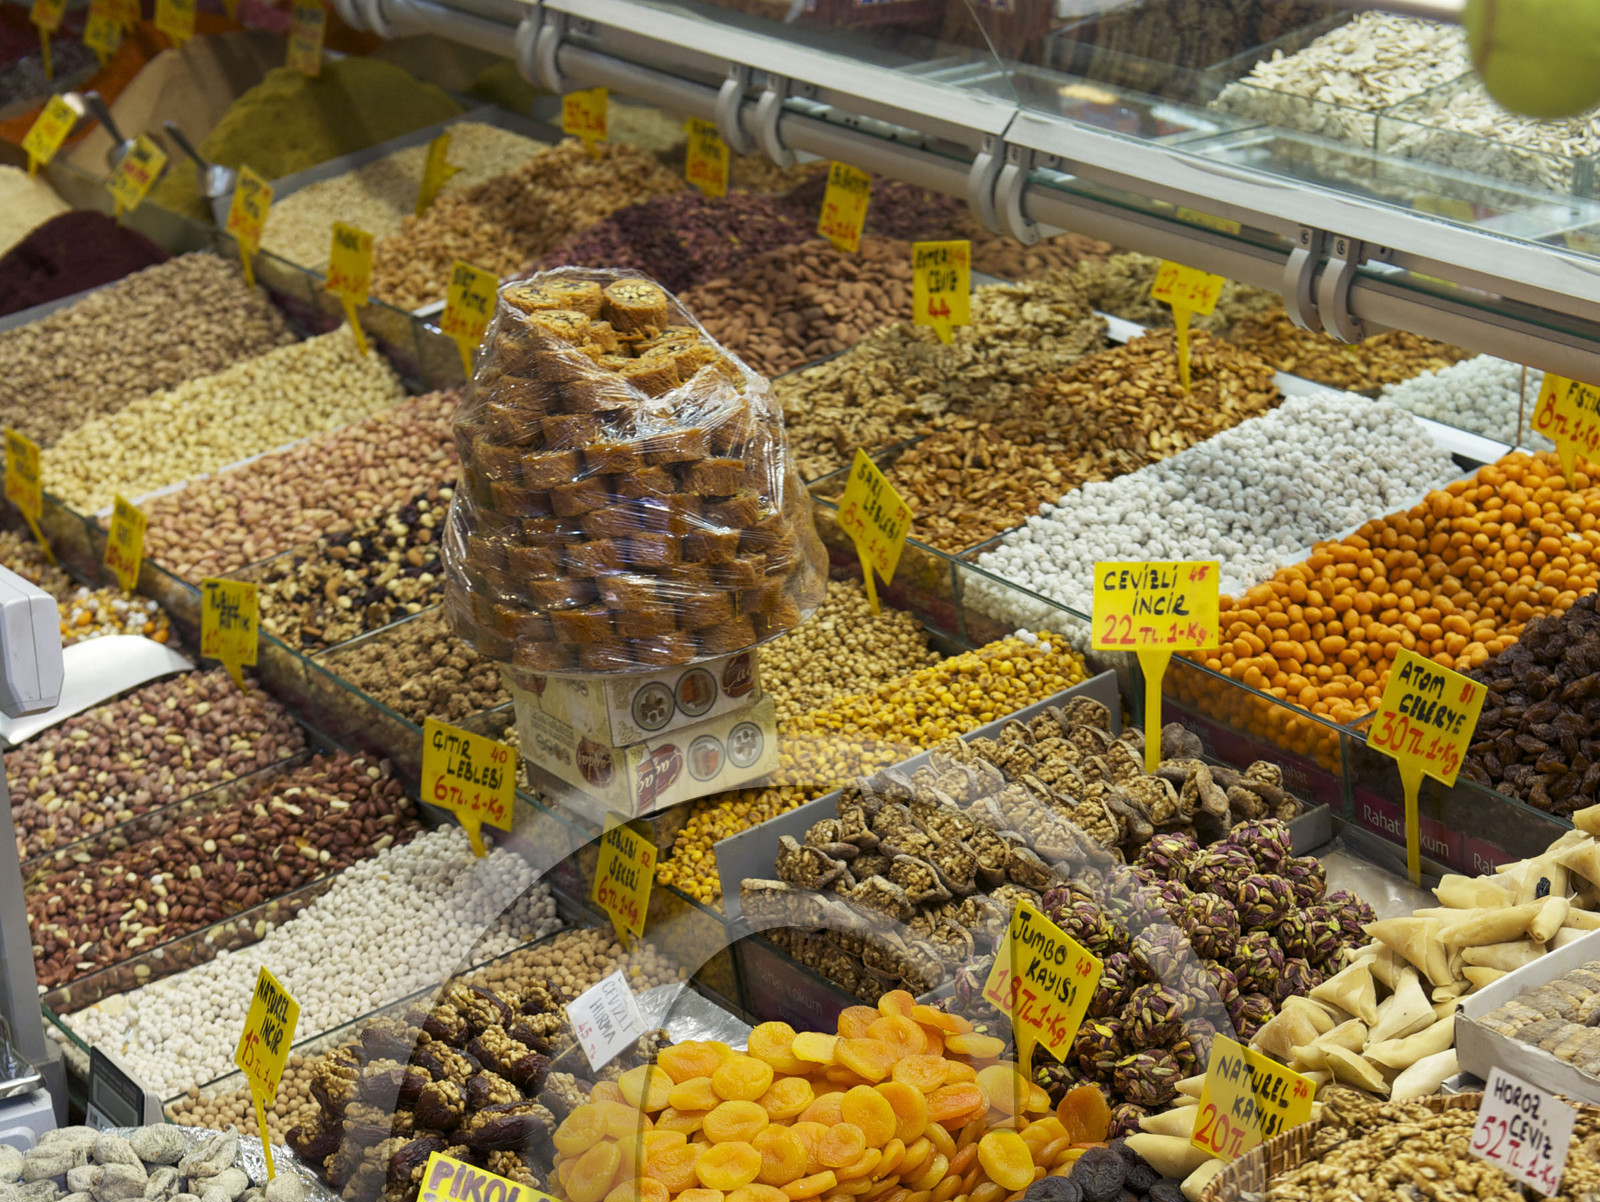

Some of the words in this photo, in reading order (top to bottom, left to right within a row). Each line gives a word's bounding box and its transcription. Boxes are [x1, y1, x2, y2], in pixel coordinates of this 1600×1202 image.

[1100, 613, 1137, 645] 22
[1398, 660, 1445, 700] ATOM
[490, 746, 508, 765] 40
[1363, 804, 1401, 837] Rahat
[1012, 910, 1068, 965] JUMBO
[1217, 1054, 1290, 1109] NATUREL
